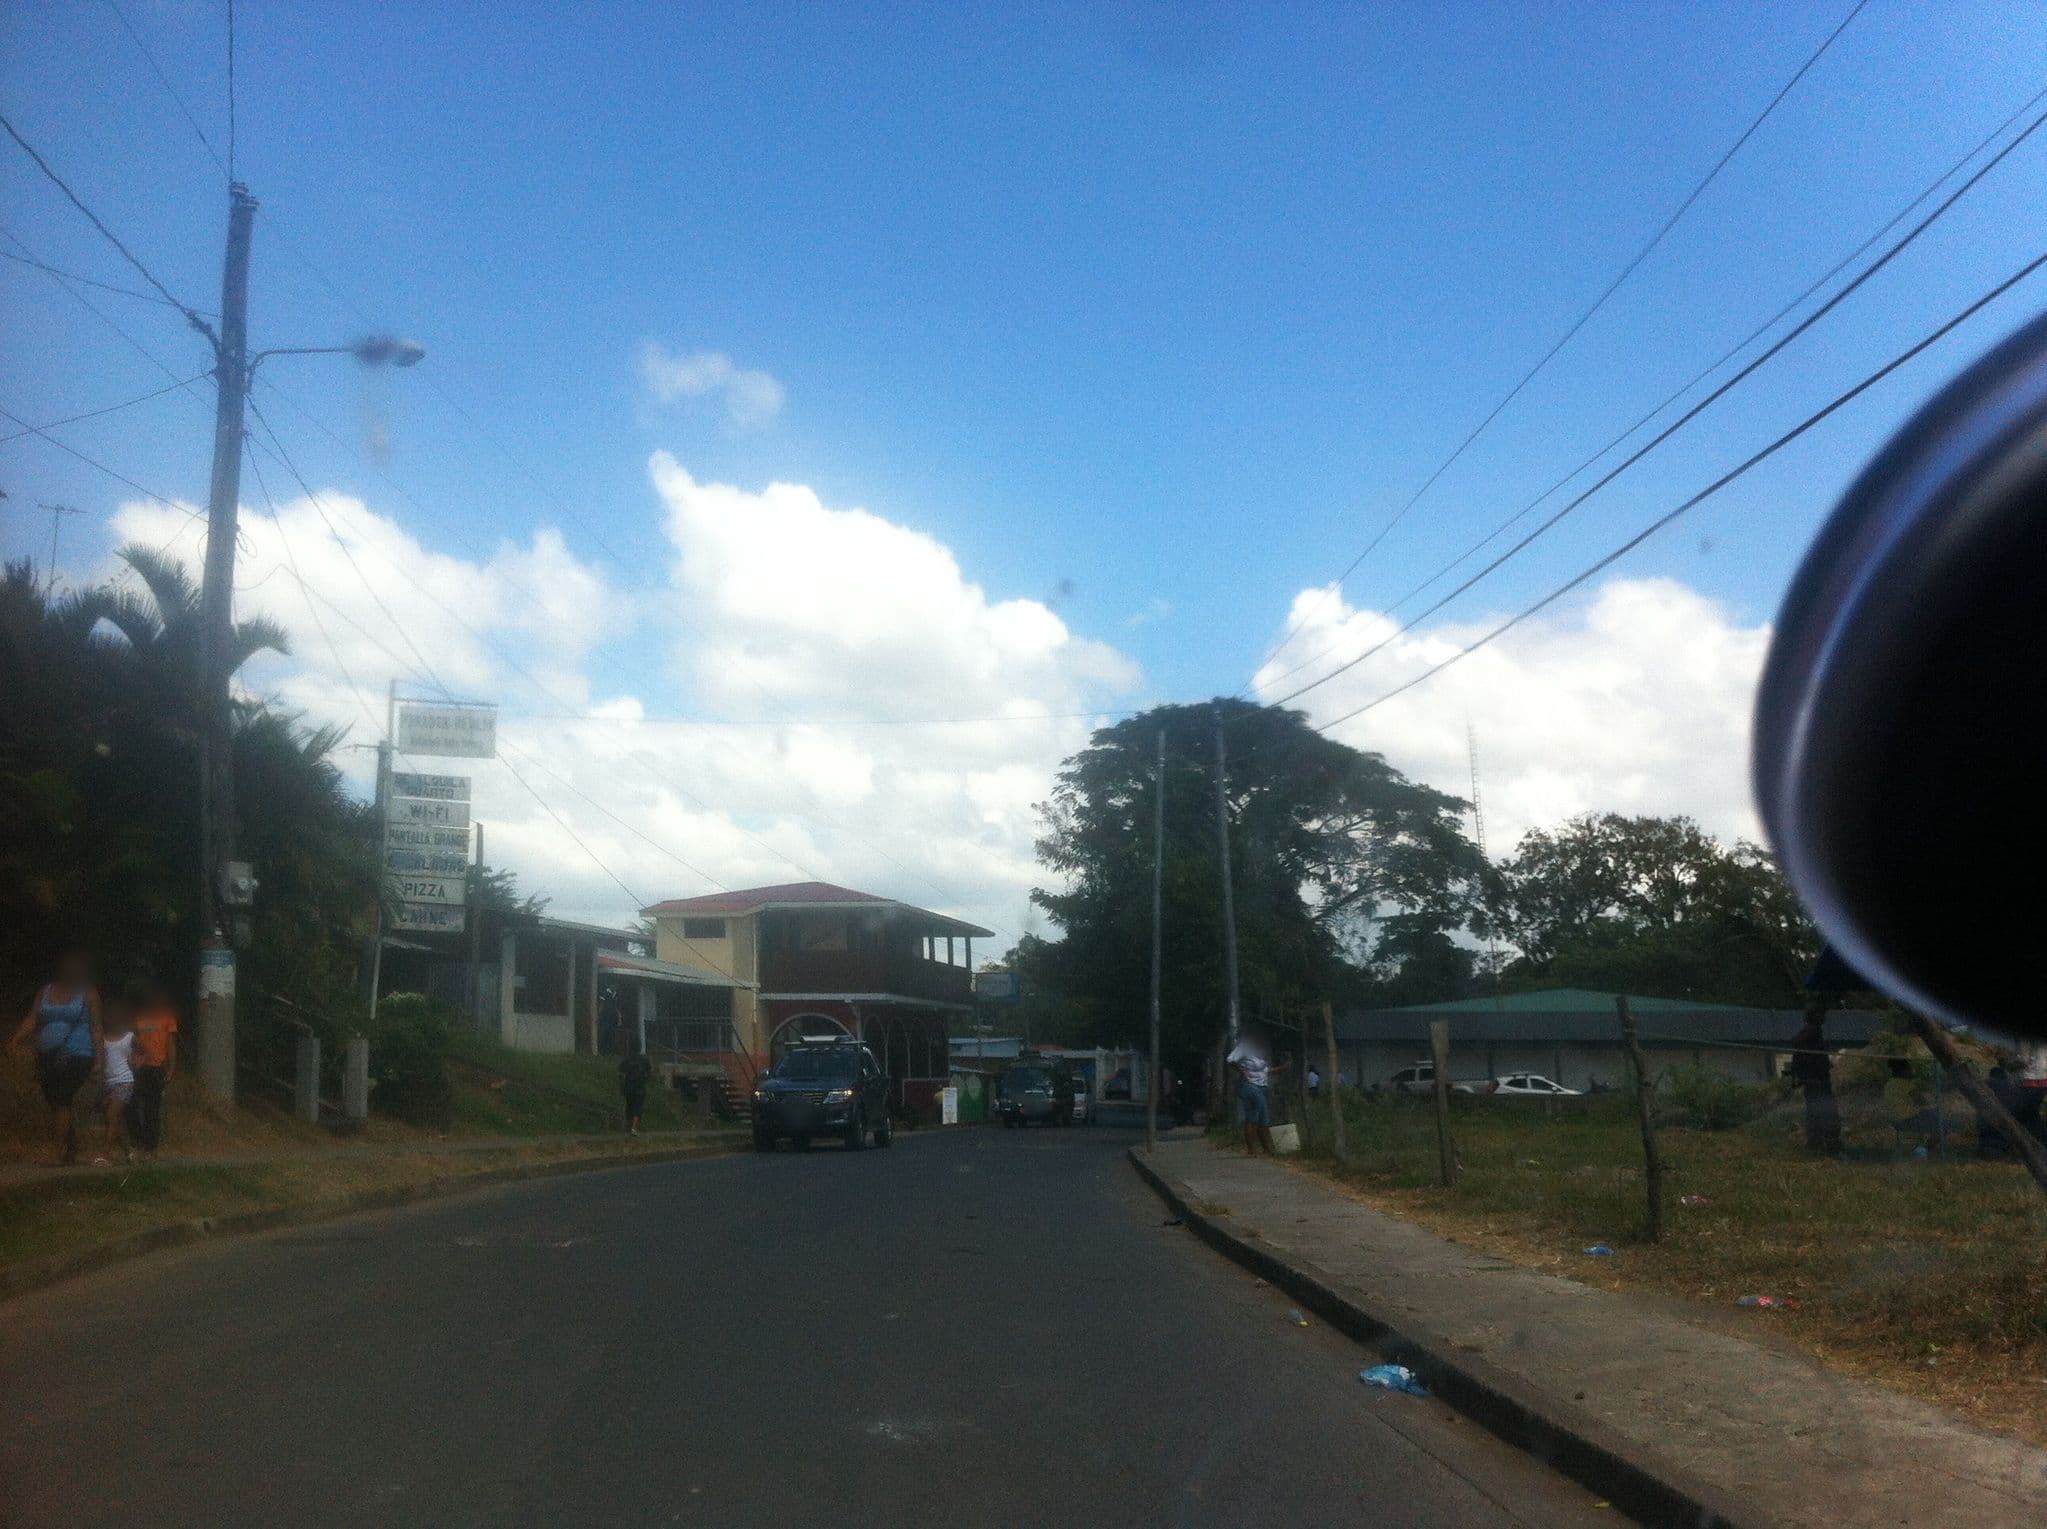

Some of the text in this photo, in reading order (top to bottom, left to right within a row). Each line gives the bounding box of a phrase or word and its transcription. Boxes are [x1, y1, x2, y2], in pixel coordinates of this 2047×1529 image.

[417, 775, 465, 788] ALQUILA
[410, 804, 449, 821] WI-FI
[388, 829, 430, 845] PANTALLA
[403, 882, 446, 898] PIZZA
